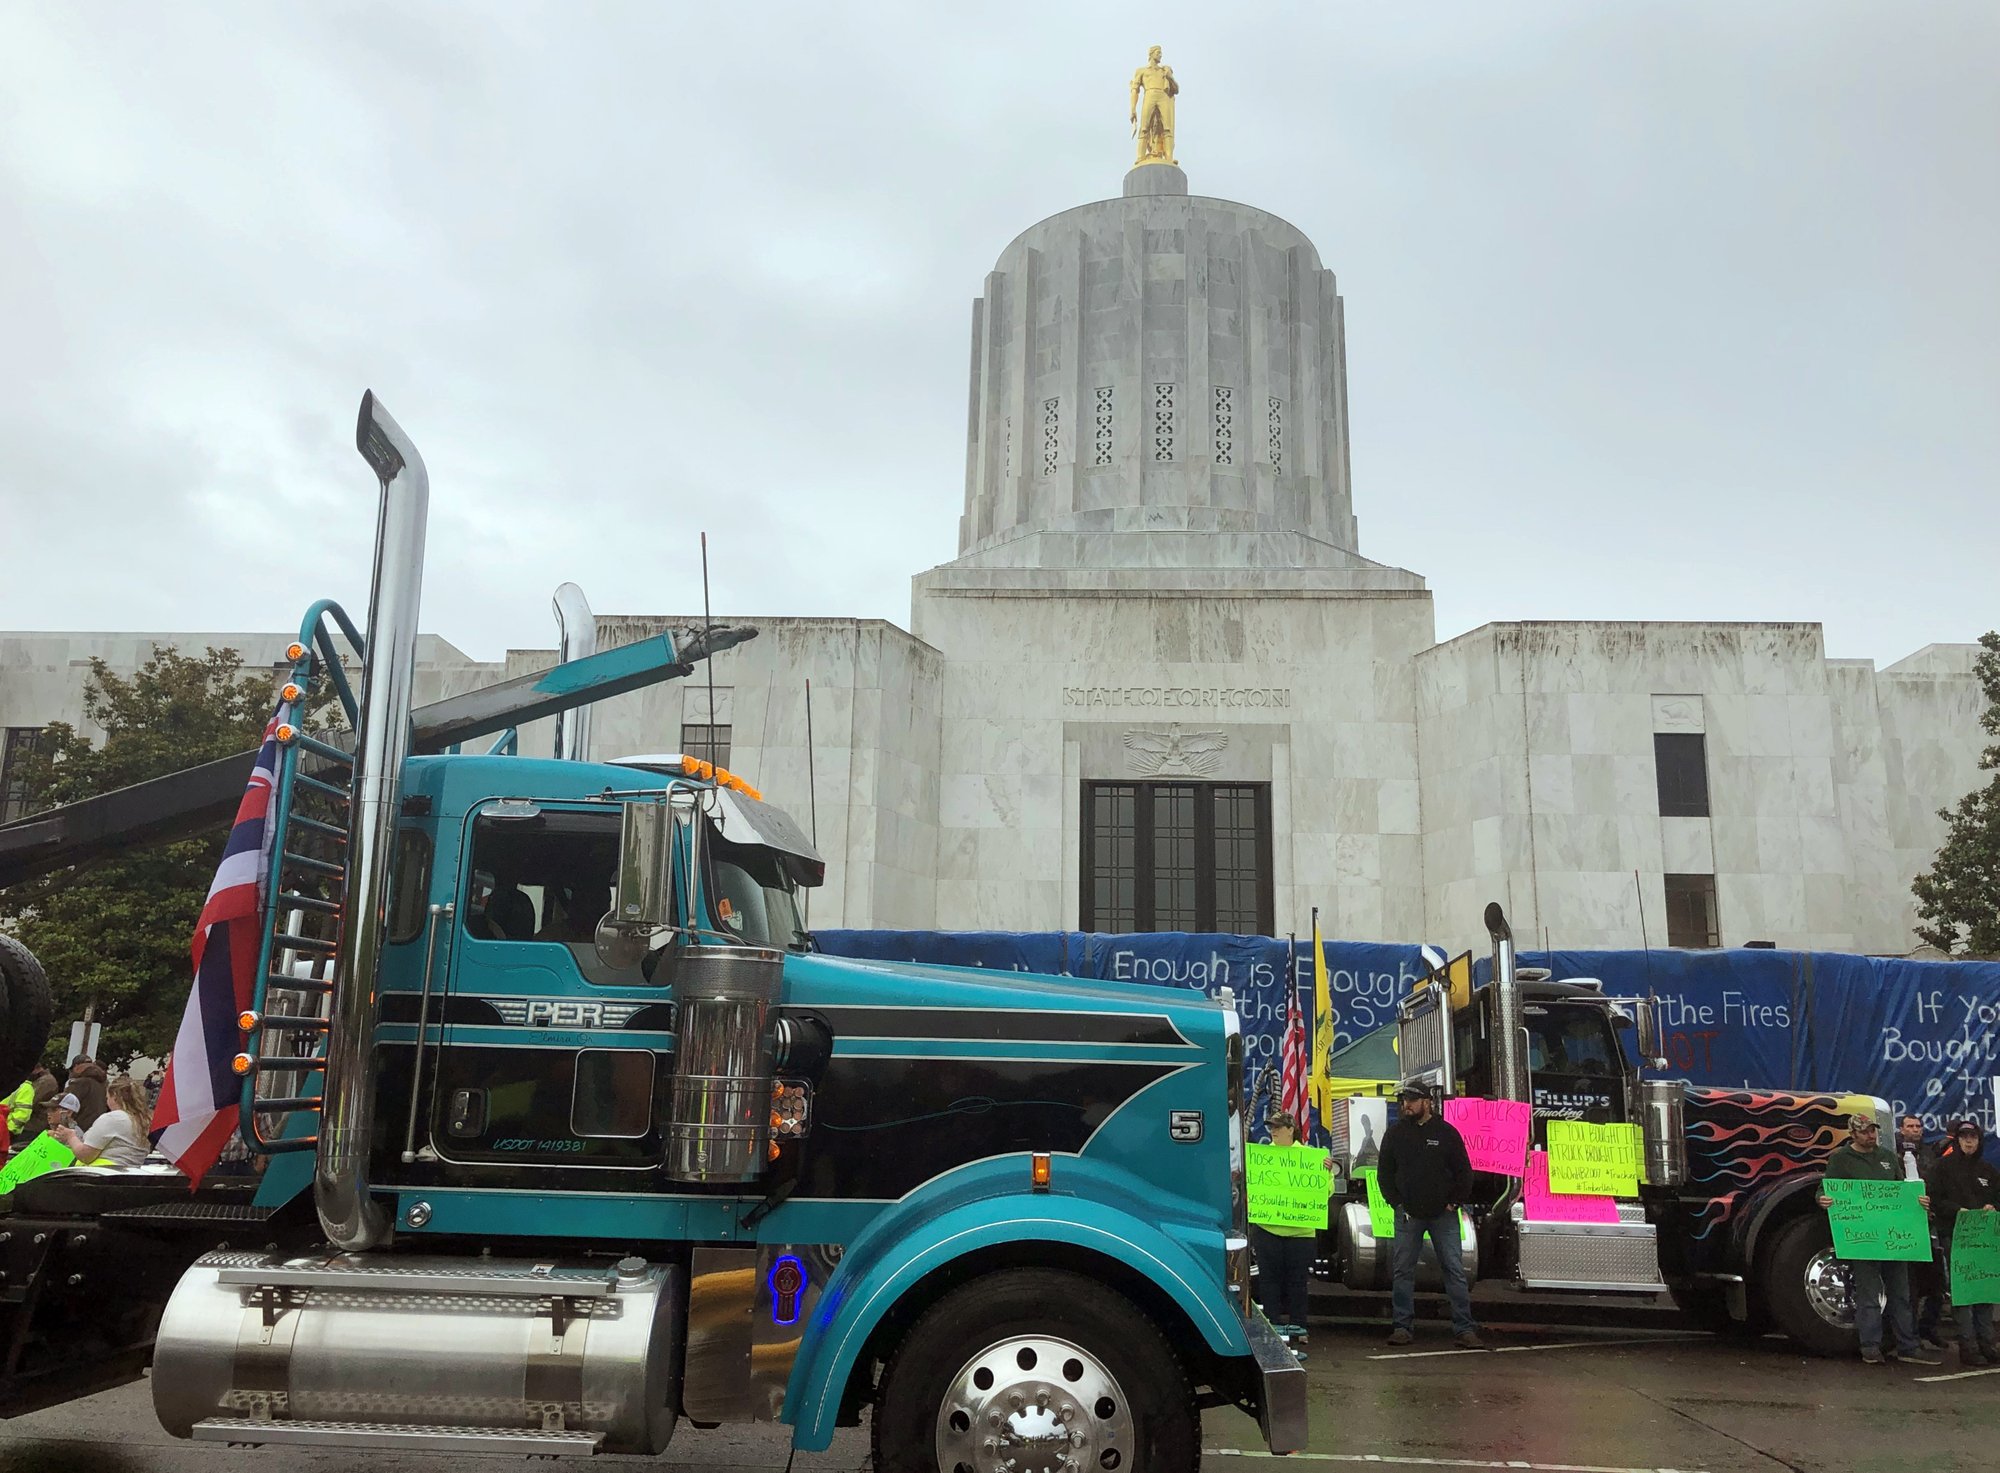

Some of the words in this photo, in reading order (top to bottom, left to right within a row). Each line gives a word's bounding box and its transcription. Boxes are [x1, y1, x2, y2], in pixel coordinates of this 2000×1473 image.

[1064, 687, 1131, 706] STATE
[1139, 688, 1171, 706] OF
[1177, 688, 1290, 707] OREGON
[1114, 950, 1229, 990] Enough
[1250, 956, 1275, 988] is
[526, 1001, 604, 1027] PER
[1235, 989, 1286, 1021] the
[1658, 993, 1715, 1027] the
[1722, 990, 1791, 1028] Fires
[1916, 990, 1943, 1024] If
[1881, 1023, 1997, 1073] Bought
[1535, 1089, 1610, 1107] FILLUP'S
[1447, 1101, 1469, 1121] NO
[1472, 1100, 1529, 1124] TRUCKS
[1532, 1107, 1585, 1120] Trucking
[1892, 1098, 1996, 1133] Bouht
[1169, 1109, 1202, 1142] 5
[1566, 1122, 1585, 1142] YOU
[1589, 1124, 1620, 1144] BOUGHT
[493, 1138, 535, 1150] USDOT
[1555, 1144, 1584, 1161] TRUCK
[1585, 1144, 1614, 1163] BROUGHT
[1249, 1145, 1274, 1166] hose
[1280, 1151, 1297, 1168] who
[1300, 1151, 1315, 1171] live
[1288, 1171, 1327, 1190] WOOD
[1826, 1181, 1838, 1192] NO
[1842, 1181, 1854, 1192] ON
